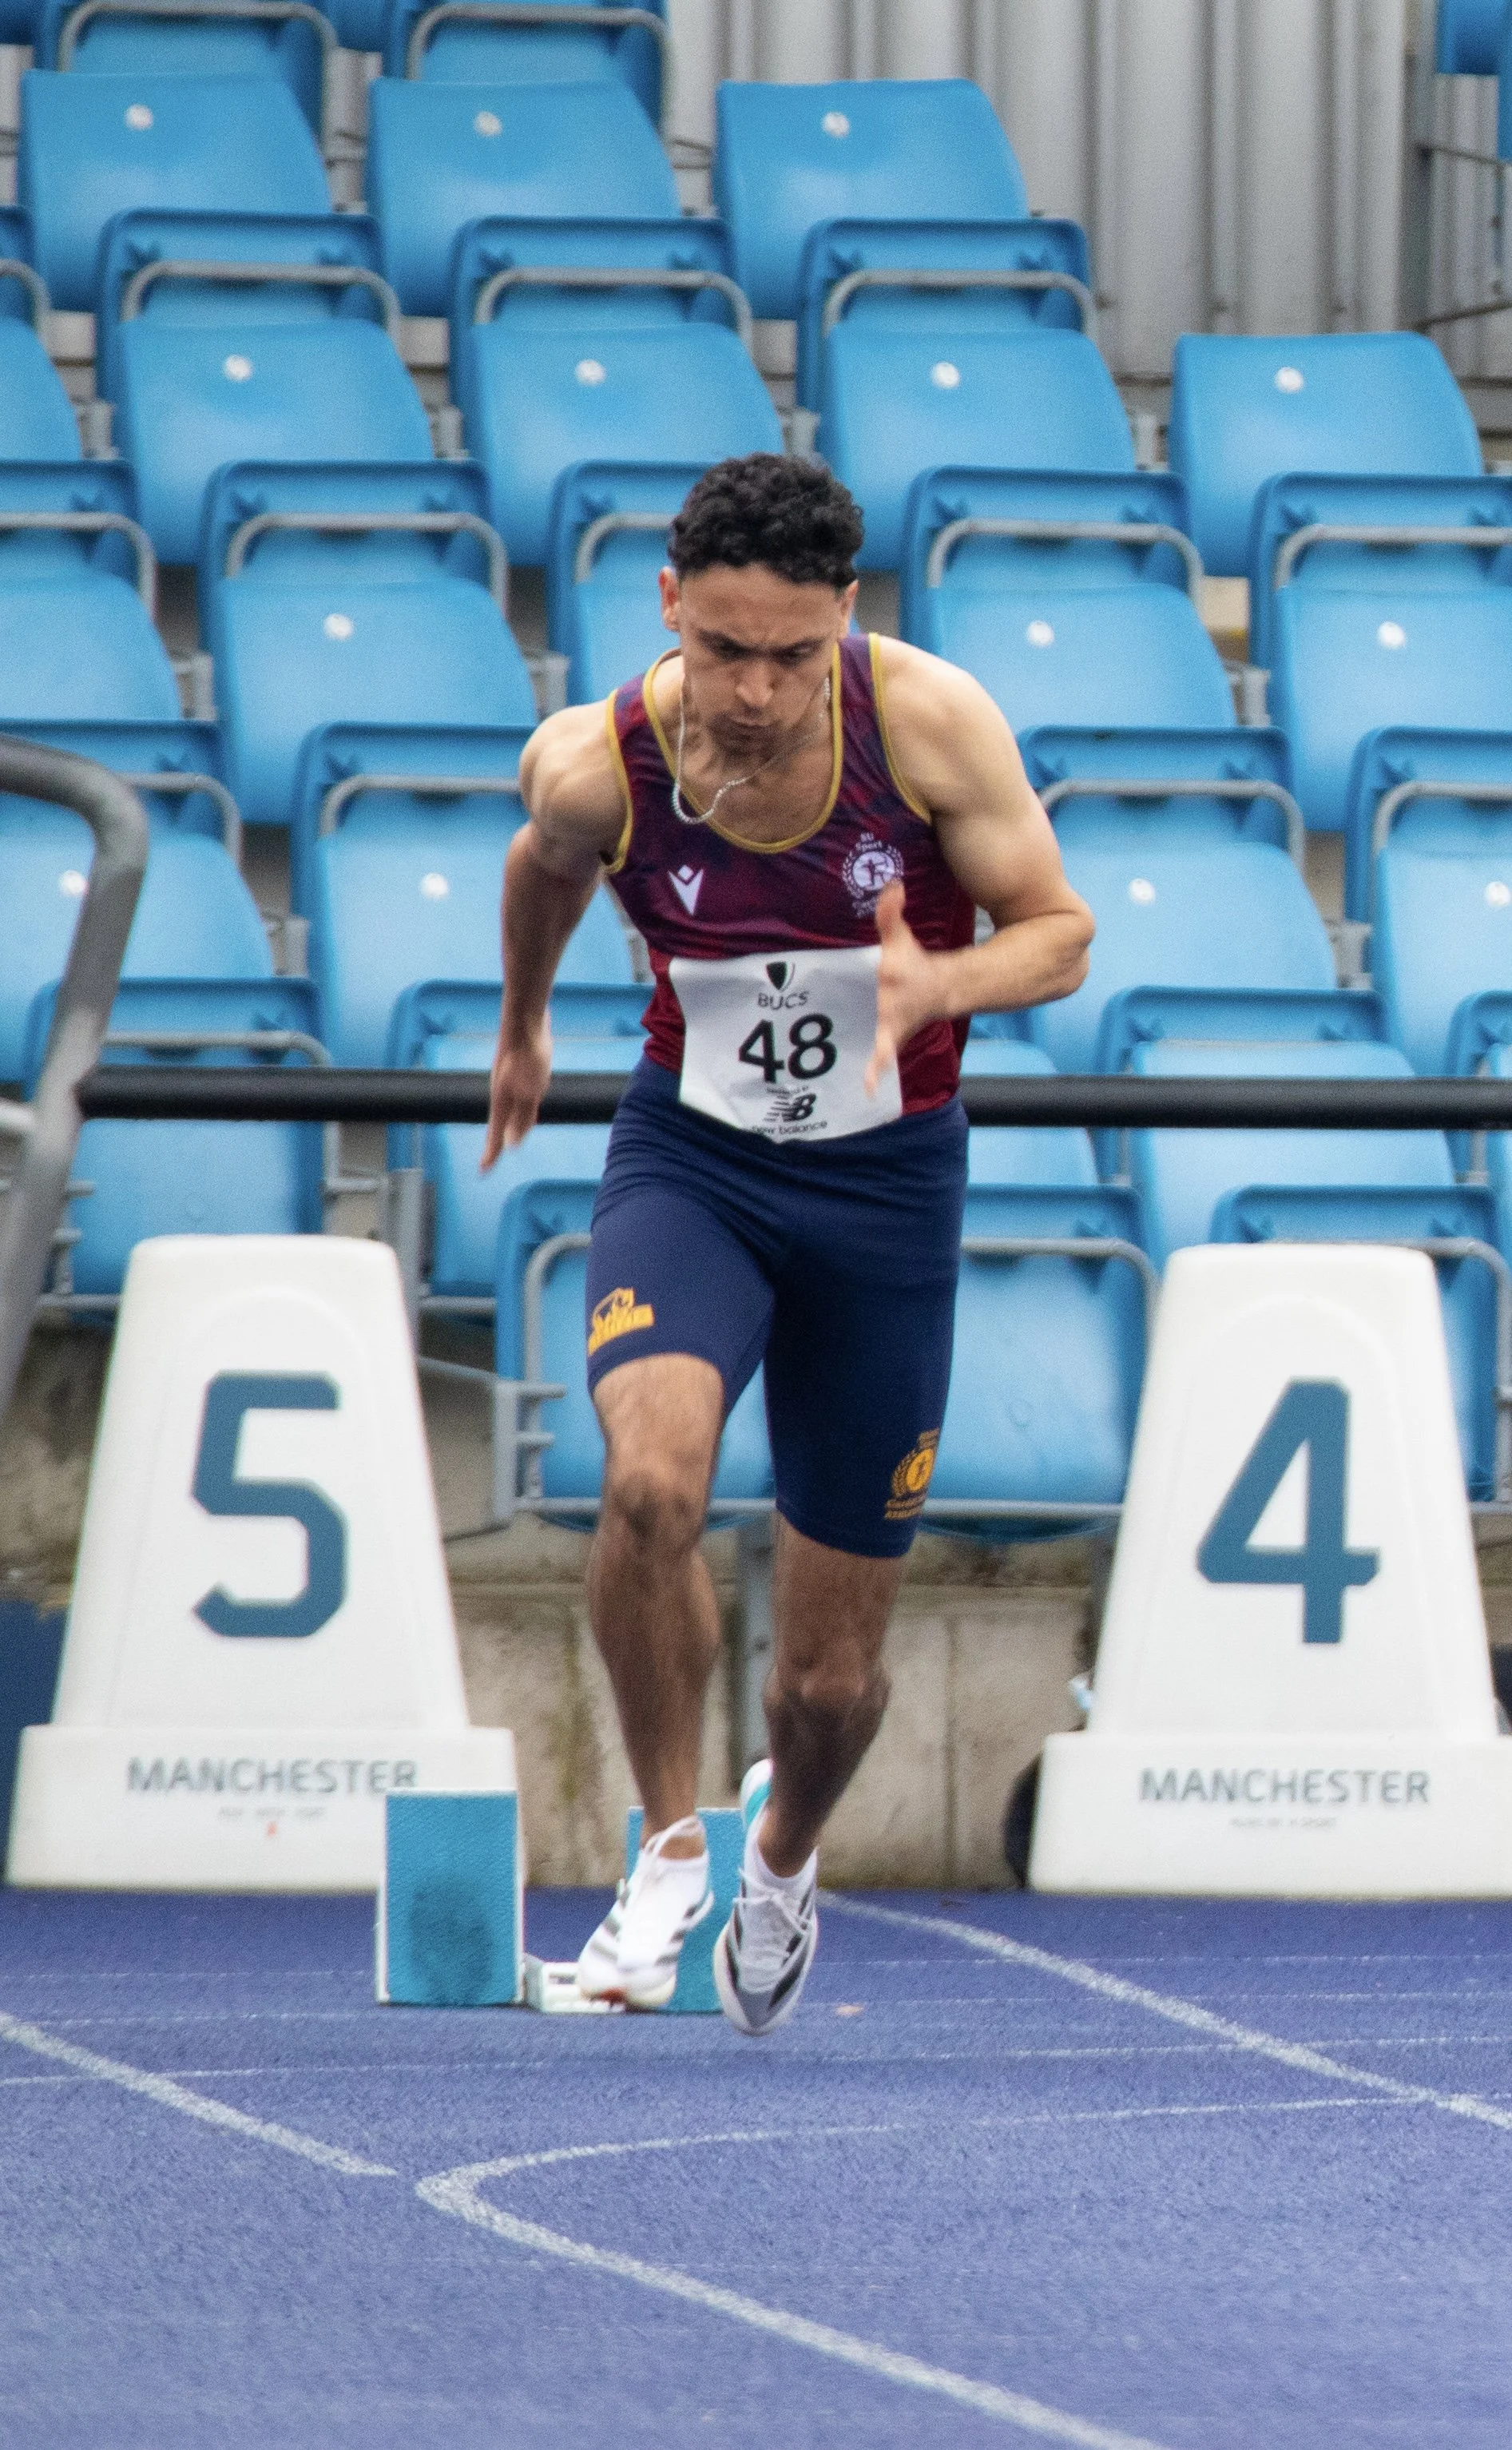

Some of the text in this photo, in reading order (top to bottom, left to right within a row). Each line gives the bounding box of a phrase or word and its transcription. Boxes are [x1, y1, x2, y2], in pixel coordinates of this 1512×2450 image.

[758, 991, 808, 1010] BUCS
[738, 1013, 837, 1084] 48
[779, 1121, 827, 1134] balance
[191, 1370, 349, 1640] 5
[1196, 1376, 1379, 1643] 4
[127, 1757, 417, 1794] MANCHESTER
[1140, 1767, 1431, 1805] MANCHESTER
